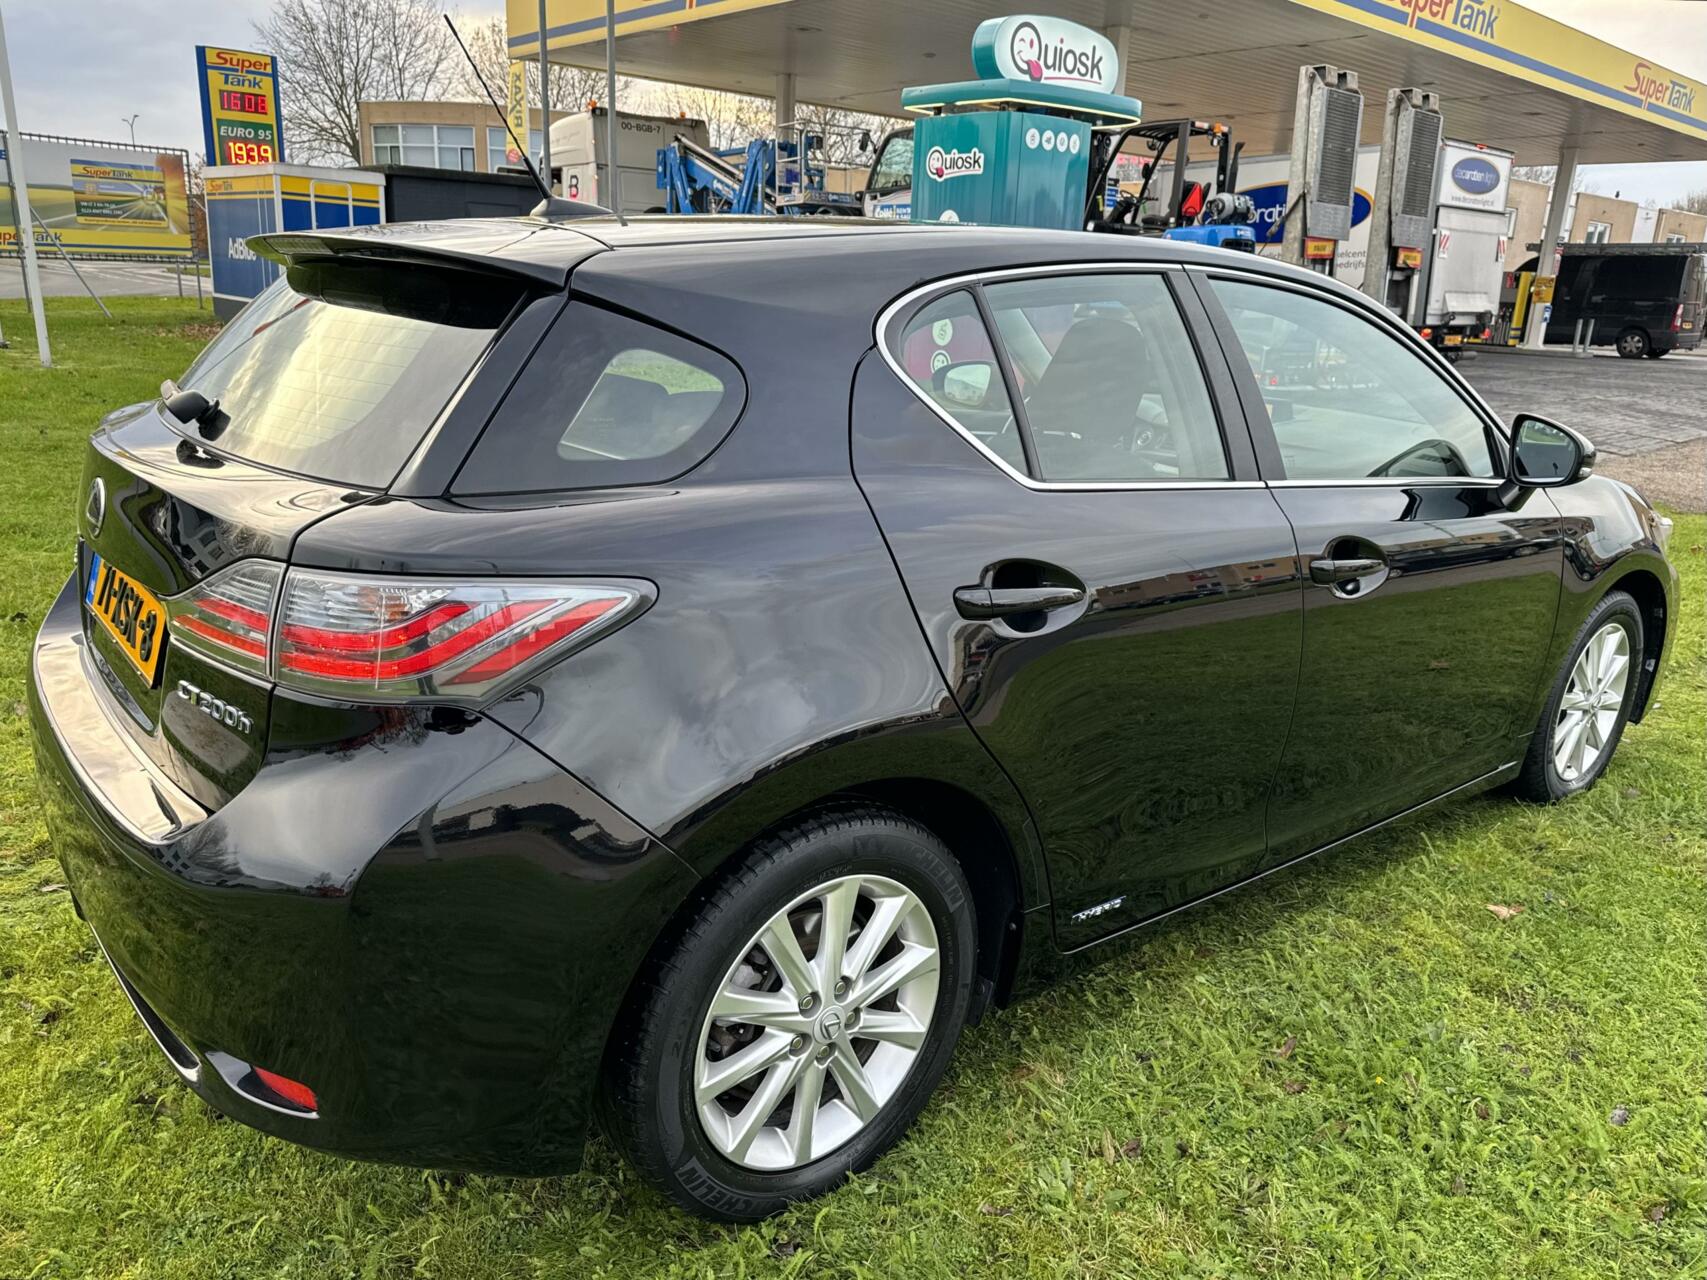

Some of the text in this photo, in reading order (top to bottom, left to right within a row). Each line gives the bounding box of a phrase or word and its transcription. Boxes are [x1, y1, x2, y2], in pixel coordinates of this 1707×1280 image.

[208, 52, 271, 73] Super
[1010, 21, 1103, 83] Quiosk
[218, 72, 263, 89] Tank
[1623, 61, 1696, 113] SuperTank
[220, 126, 272, 140] EURO 95
[928, 149, 981, 178] Quiosk
